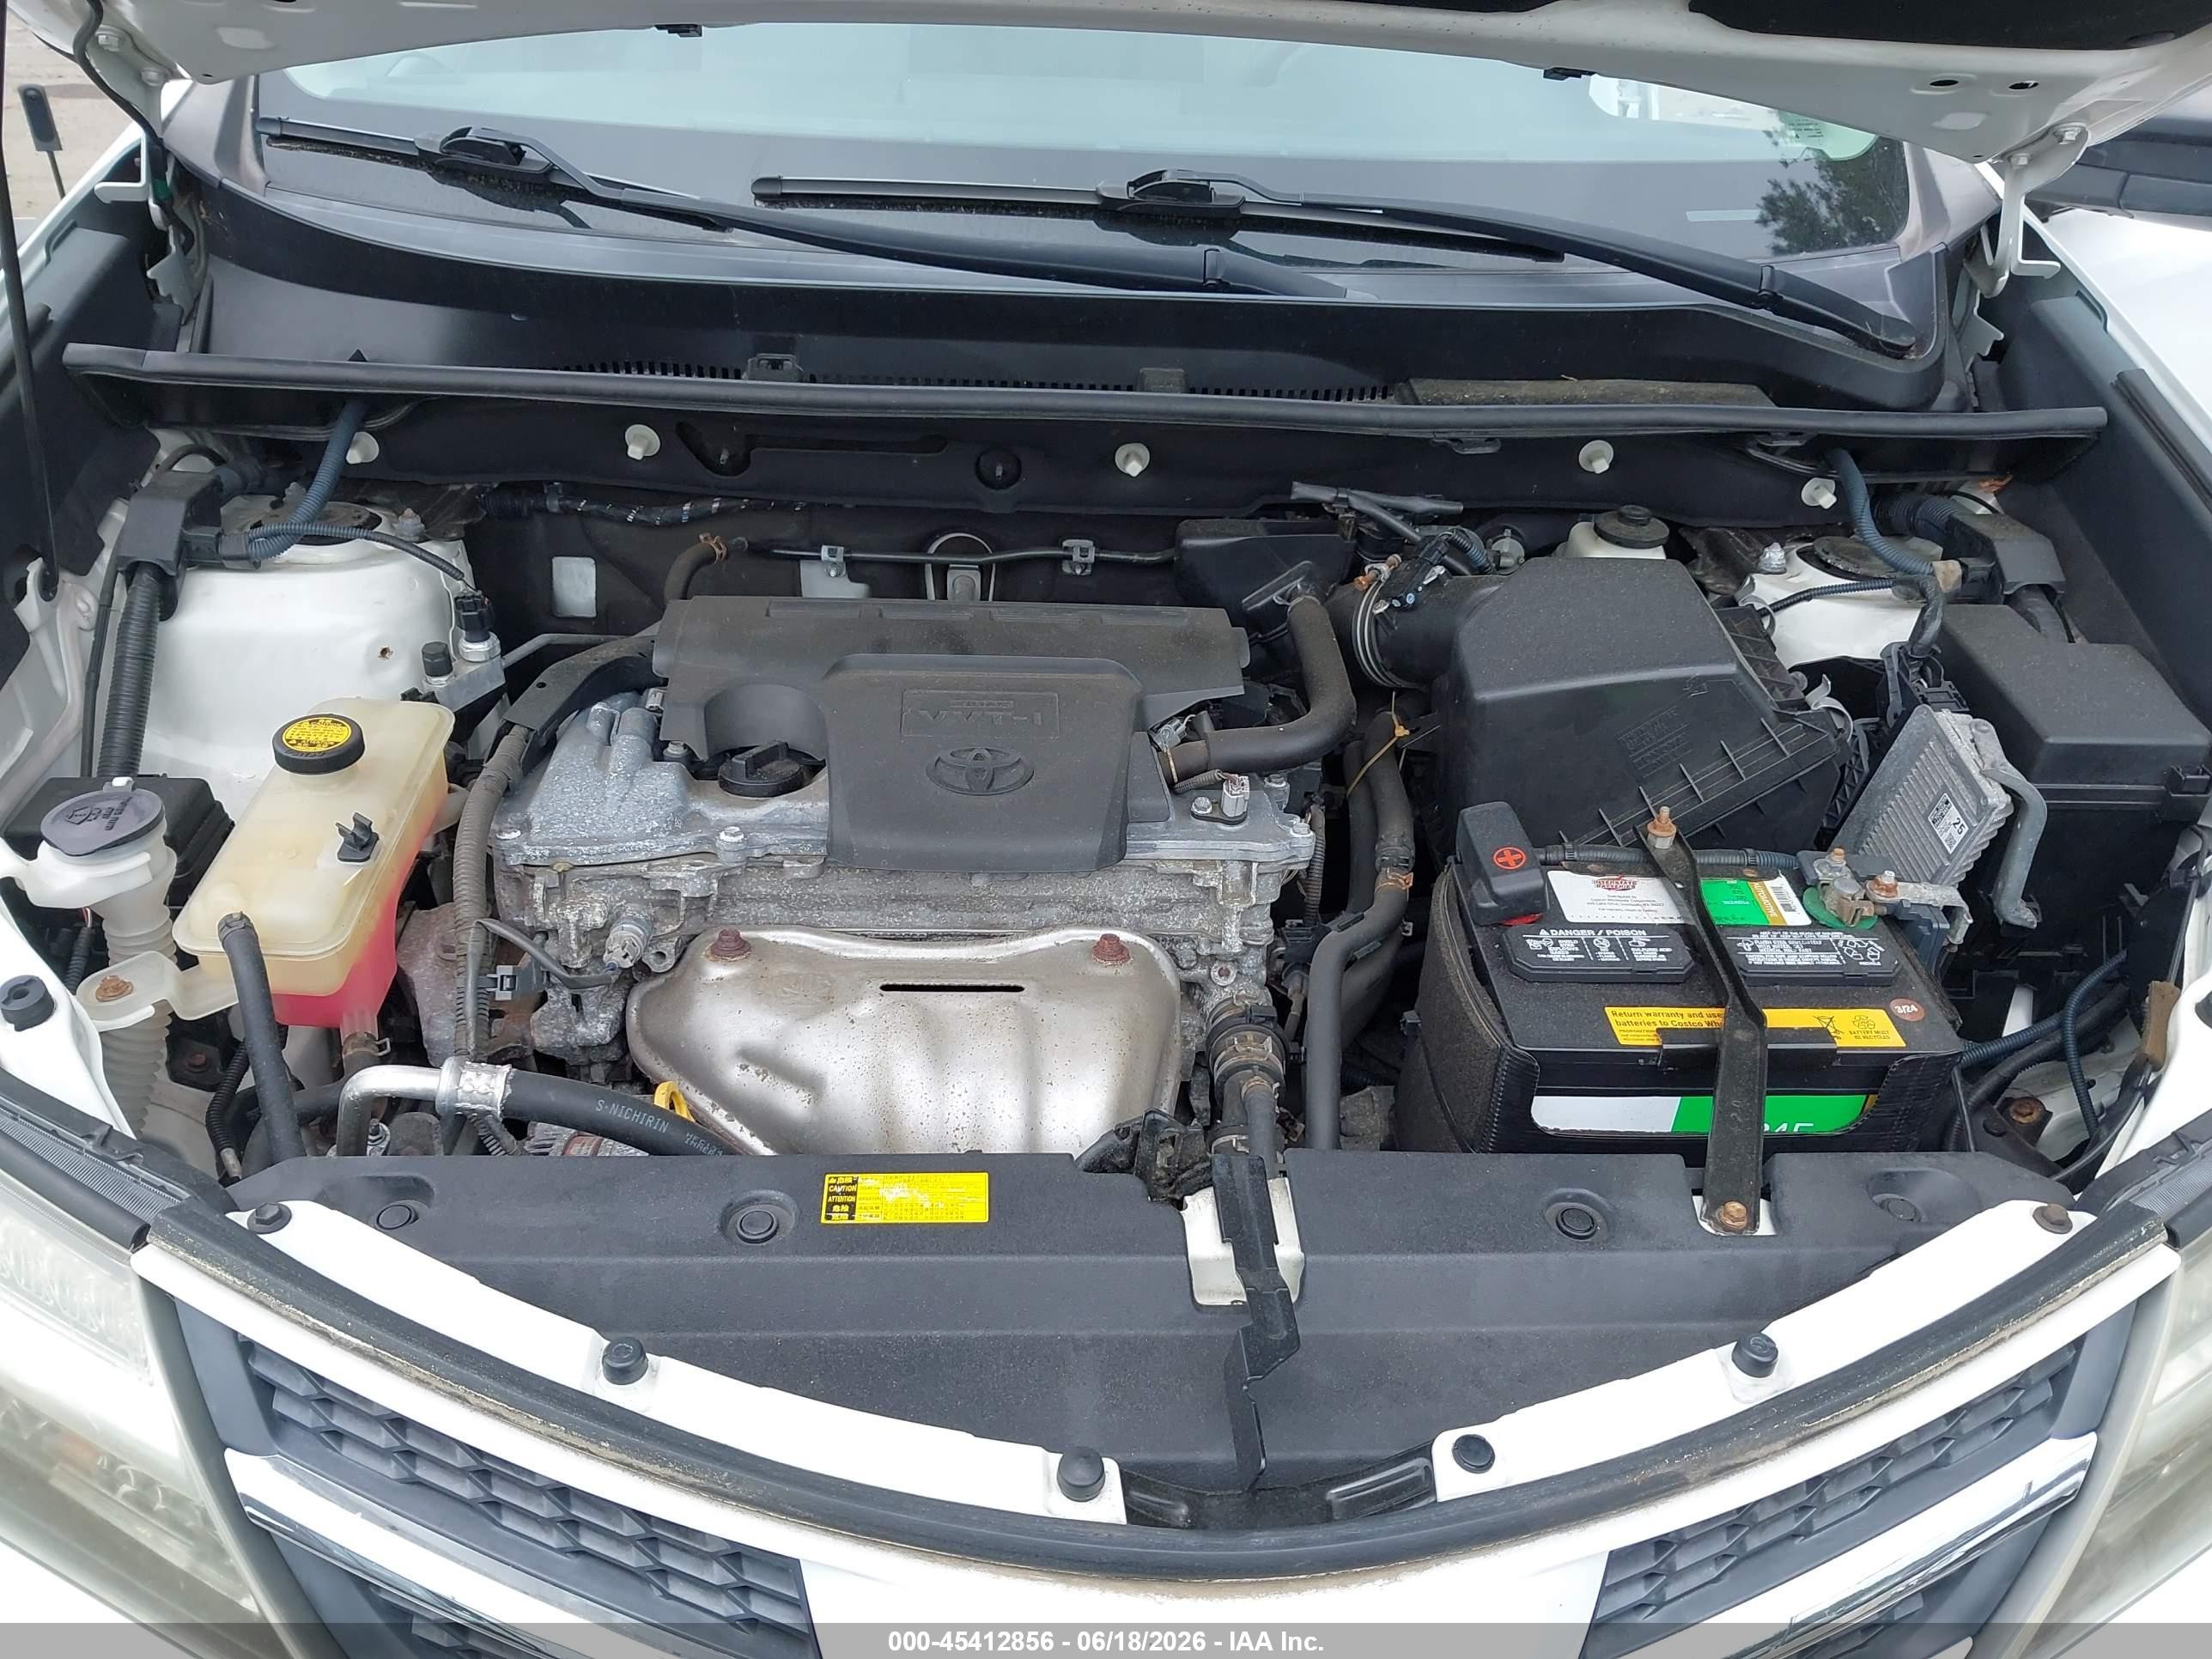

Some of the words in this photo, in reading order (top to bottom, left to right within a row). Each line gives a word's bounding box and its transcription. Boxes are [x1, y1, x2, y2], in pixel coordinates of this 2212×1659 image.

[1952, 817, 1966, 835] 25
[1753, 882, 1778, 918] AUTOMOTIVE
[1894, 1005, 1918, 1014] 3/24
